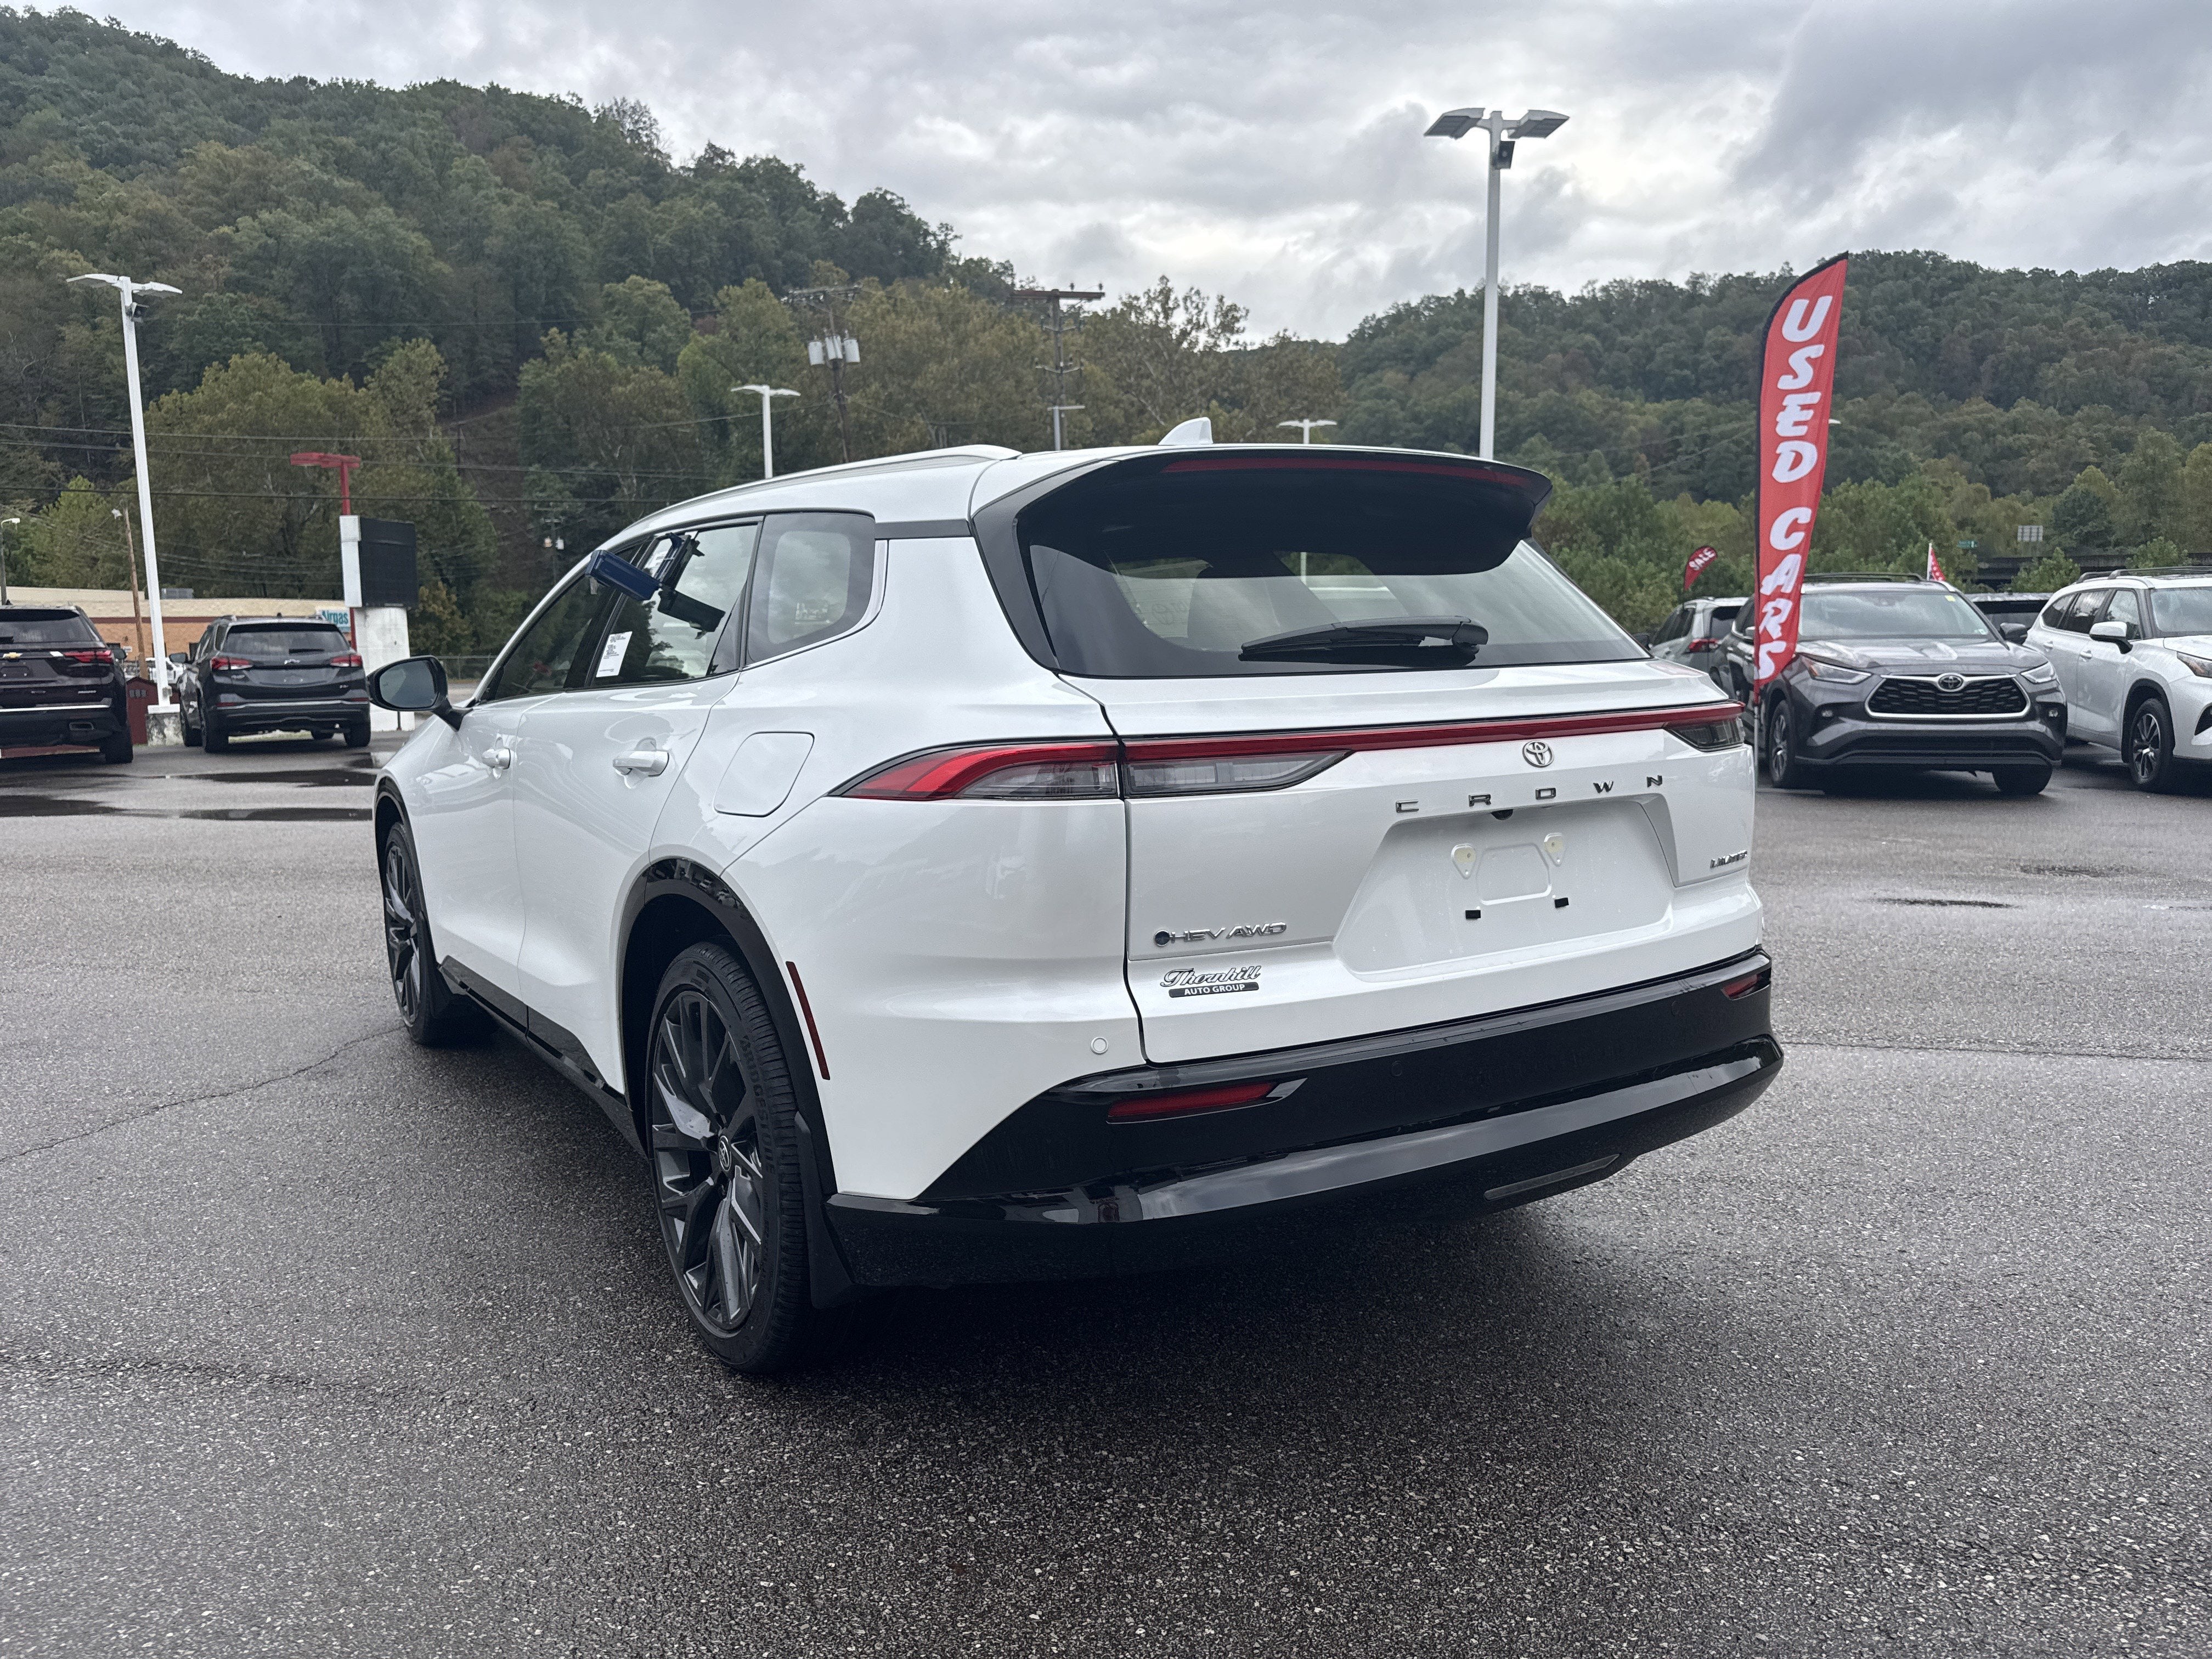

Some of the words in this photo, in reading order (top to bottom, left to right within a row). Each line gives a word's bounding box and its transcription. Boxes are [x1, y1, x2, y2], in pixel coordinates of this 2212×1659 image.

[1772, 295, 1833, 483] USED
[1689, 547, 1716, 571] SALE
[1754, 507, 1812, 680] CARS
[1395, 774, 1663, 814] CROWN
[1170, 927, 1226, 943] HEV
[1226, 921, 1287, 939] AWD
[1159, 965, 1262, 988] Thornhill
[1183, 986, 1211, 996] AUTO
[1211, 983, 1245, 993] GROUP
[741, 1035, 775, 1175] BRIDGESTONE
